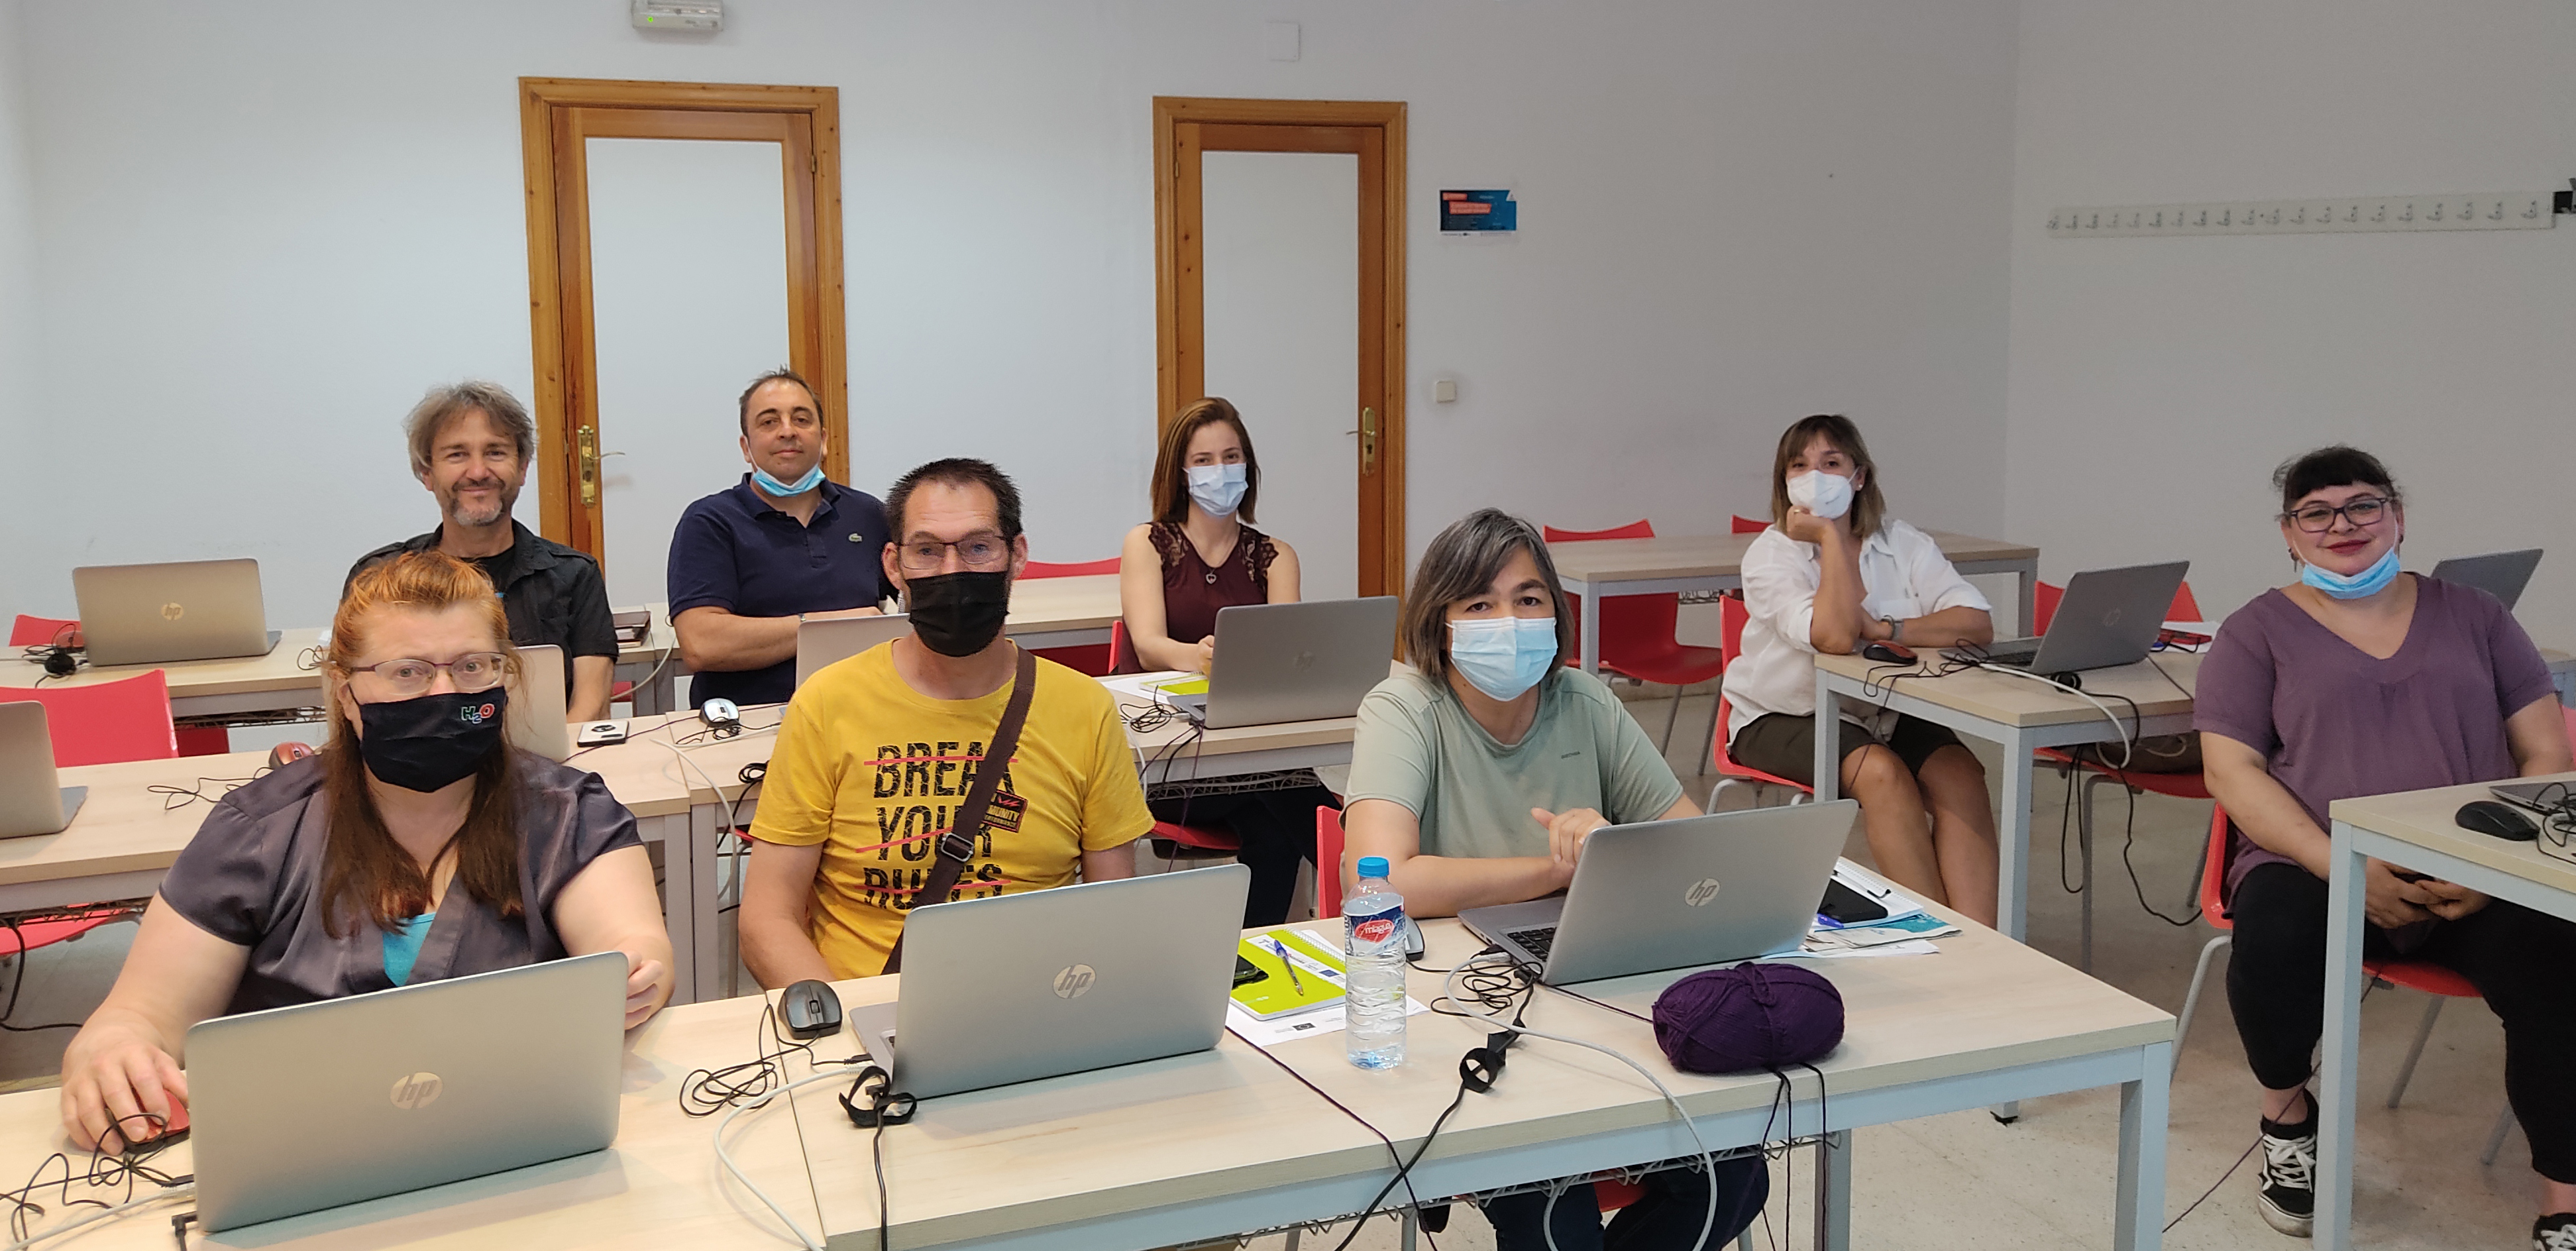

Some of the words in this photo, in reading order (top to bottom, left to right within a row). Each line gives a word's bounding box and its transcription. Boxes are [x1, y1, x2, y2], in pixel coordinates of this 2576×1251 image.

[165, 604, 182, 620] hp
[460, 703, 495, 724] H2O
[863, 863, 1003, 910] RUS
[1688, 879, 1717, 906] hp
[1057, 965, 1092, 999] hp
[397, 1073, 437, 1109] hp
